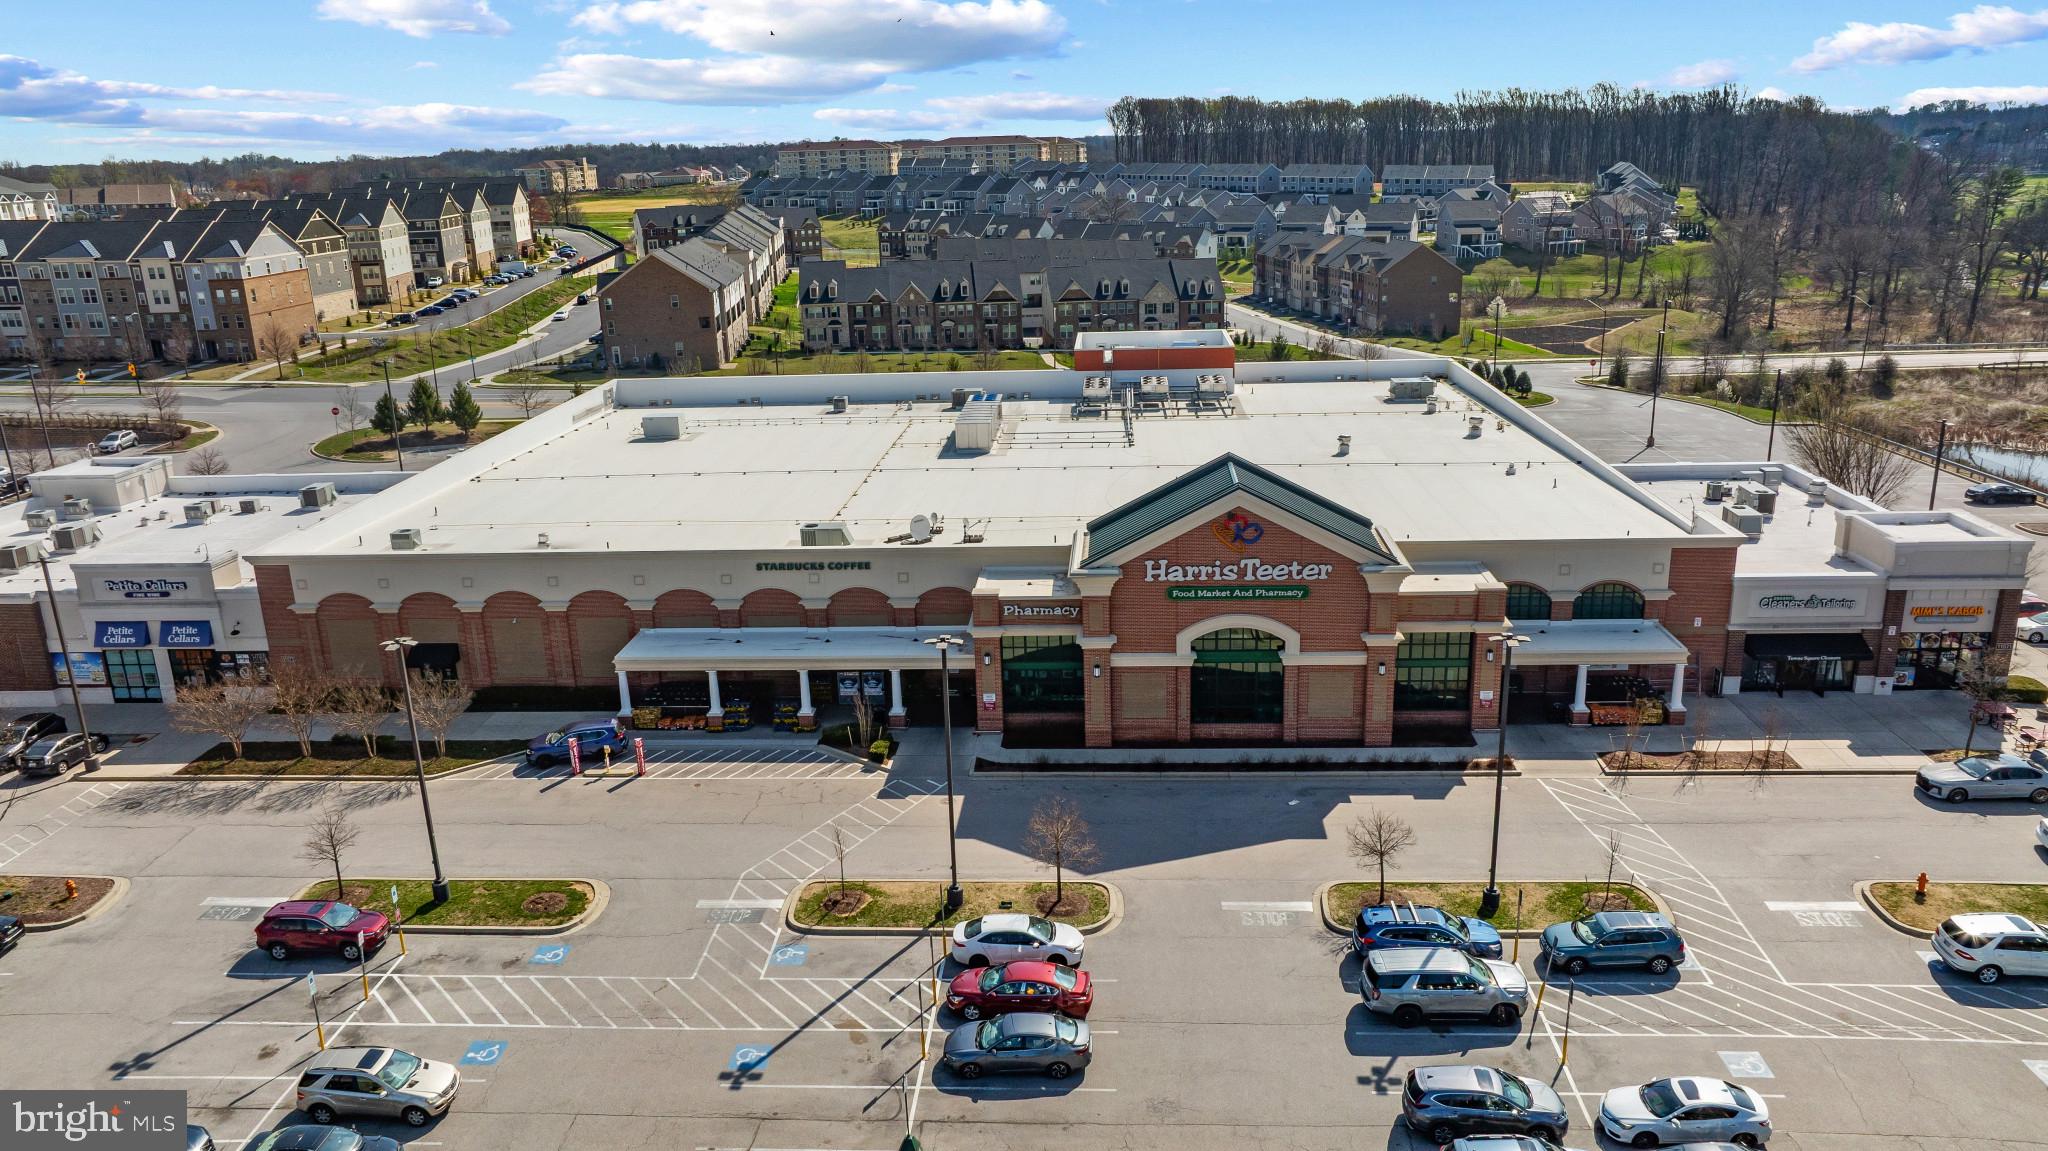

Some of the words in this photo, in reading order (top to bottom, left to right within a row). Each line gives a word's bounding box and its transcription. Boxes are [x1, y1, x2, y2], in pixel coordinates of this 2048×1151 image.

[756, 562, 825, 571] STARBUCKS
[827, 562, 871, 570] COFFEE
[1144, 560, 1238, 582] Harris
[1240, 558, 1332, 581] Teeter
[105, 580, 141, 591] Petite
[143, 580, 187, 591] Cellars
[1172, 590, 1195, 598] Food
[1197, 590, 1231, 598] Market
[1234, 589, 1253, 597] And
[1255, 589, 1304, 598] Pharmacy
[1760, 597, 1805, 609] Cleaners
[1821, 598, 1856, 609] Tailoring
[1003, 605, 1080, 618] Pharmacy
[1910, 606, 1945, 617] MIMI'S
[1947, 606, 1985, 617] KABOB
[107, 626, 133, 635] Petite
[172, 625, 198, 634] Petite
[103, 635, 136, 644] Cellars
[167, 634, 200, 643] Cellars
